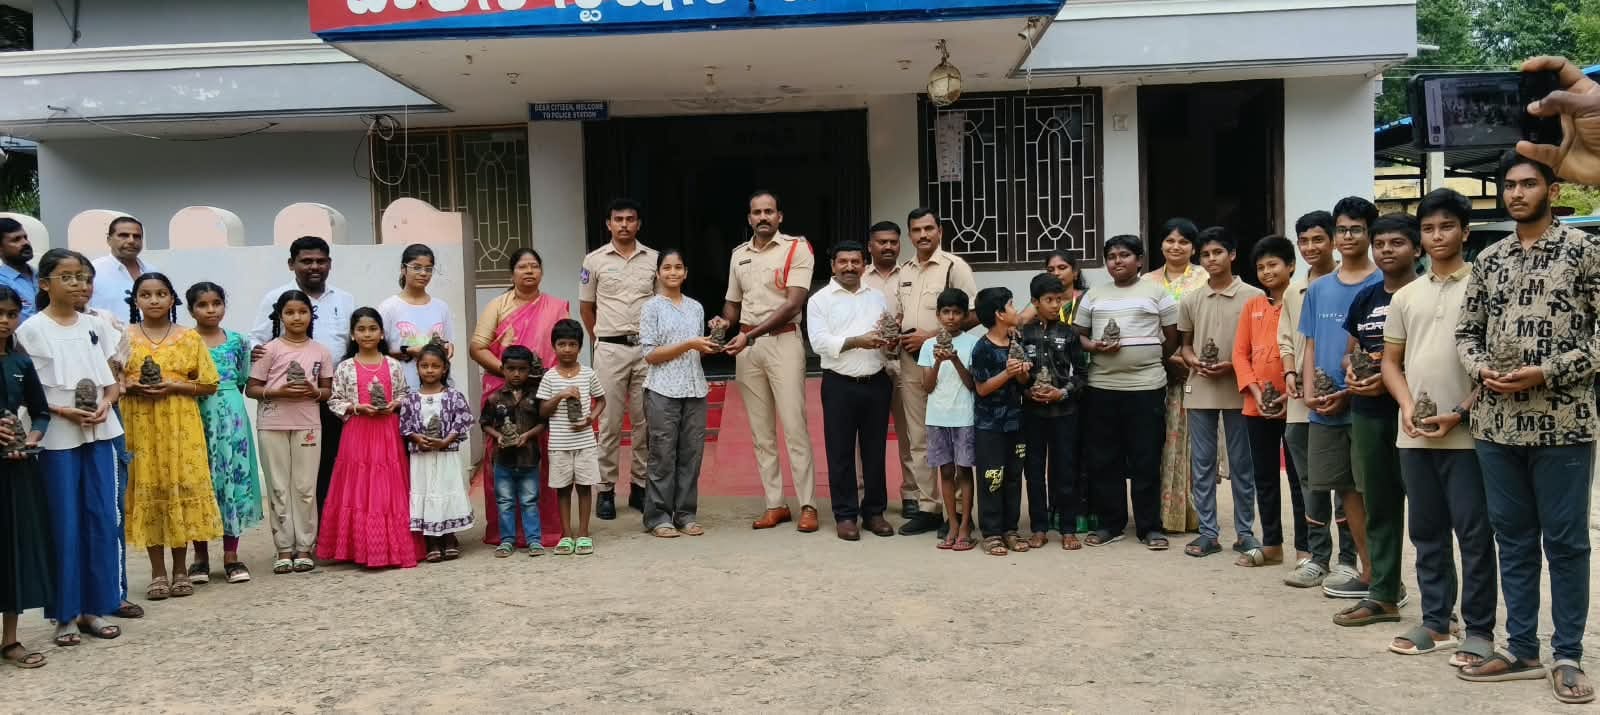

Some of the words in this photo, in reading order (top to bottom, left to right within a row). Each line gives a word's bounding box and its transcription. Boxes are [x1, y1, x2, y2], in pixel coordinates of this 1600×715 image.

[535, 103, 551, 112] DEAR
[576, 103, 604, 112] WELCOME
[543, 111, 551, 120] TO
[551, 111, 572, 120] POLICE
[572, 111, 597, 120] STATION
